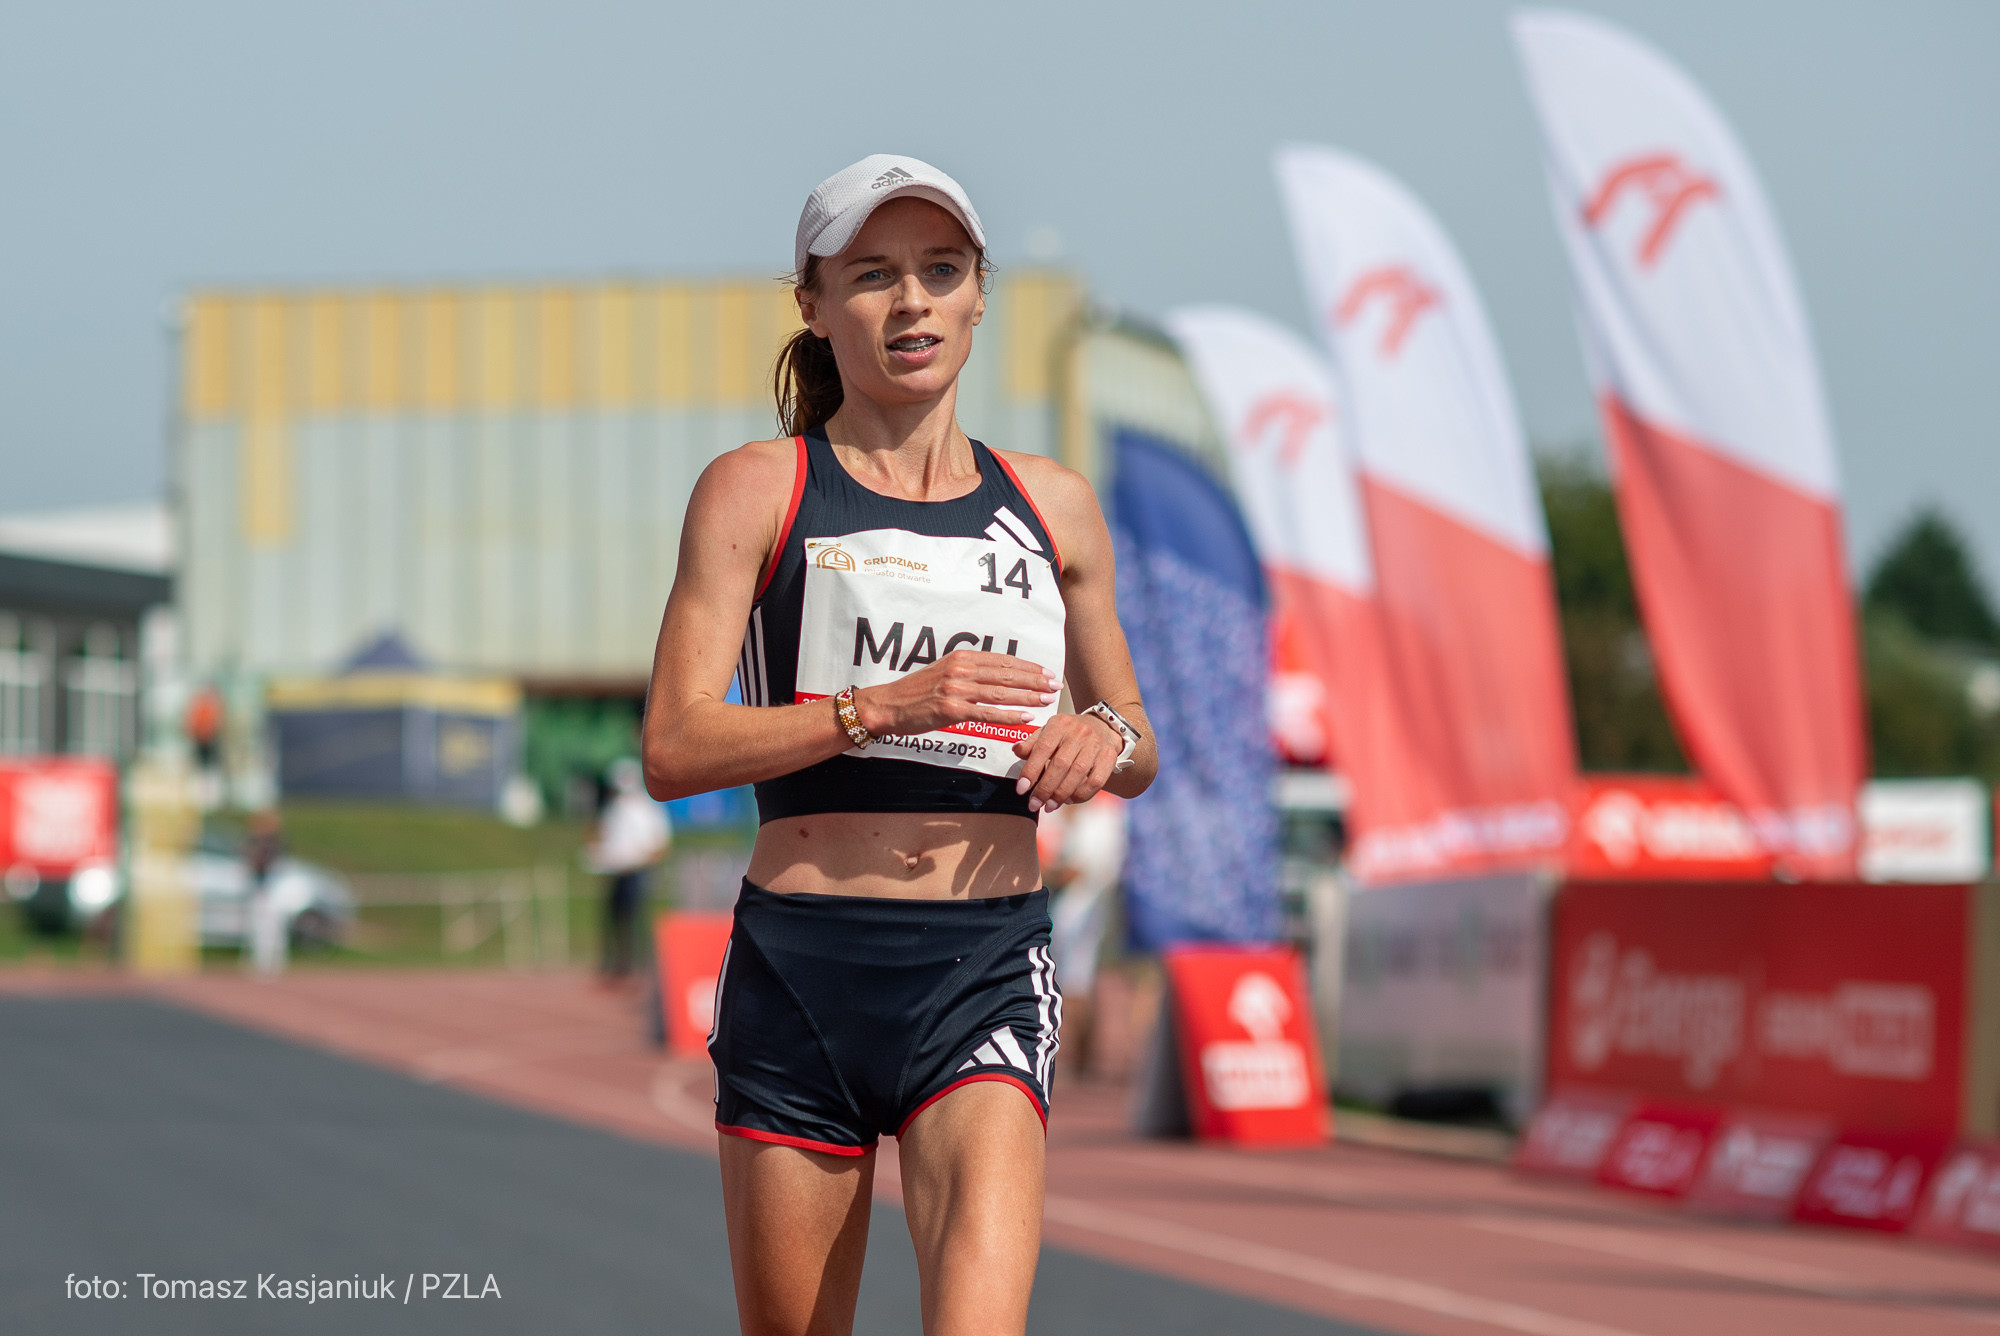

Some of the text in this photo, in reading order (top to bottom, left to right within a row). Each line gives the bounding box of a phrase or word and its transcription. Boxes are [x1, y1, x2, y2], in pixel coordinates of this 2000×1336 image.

[871, 177, 915, 190] adid
[863, 556, 928, 572] GRUDZIĄDZ
[897, 571, 931, 584] otwarte
[978, 552, 1032, 600] 14
[968, 721, 1032, 741] Półmarato
[947, 742, 987, 760] 2023
